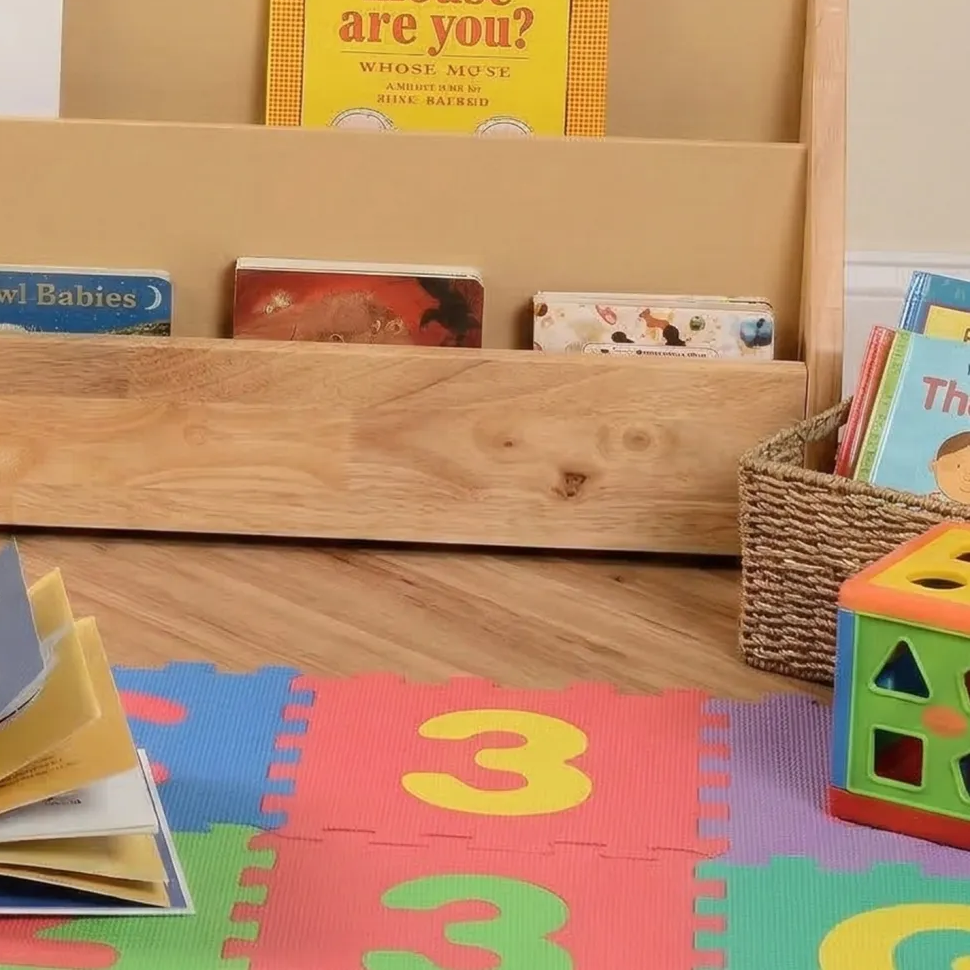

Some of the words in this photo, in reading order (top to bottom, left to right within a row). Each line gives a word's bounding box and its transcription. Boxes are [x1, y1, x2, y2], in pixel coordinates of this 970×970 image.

[338, 10, 418, 45] are
[427, 6, 535, 57] you?
[360, 62, 437, 76] WHOSE
[36, 283, 137, 308] Babies
[400, 708, 594, 817] 3
